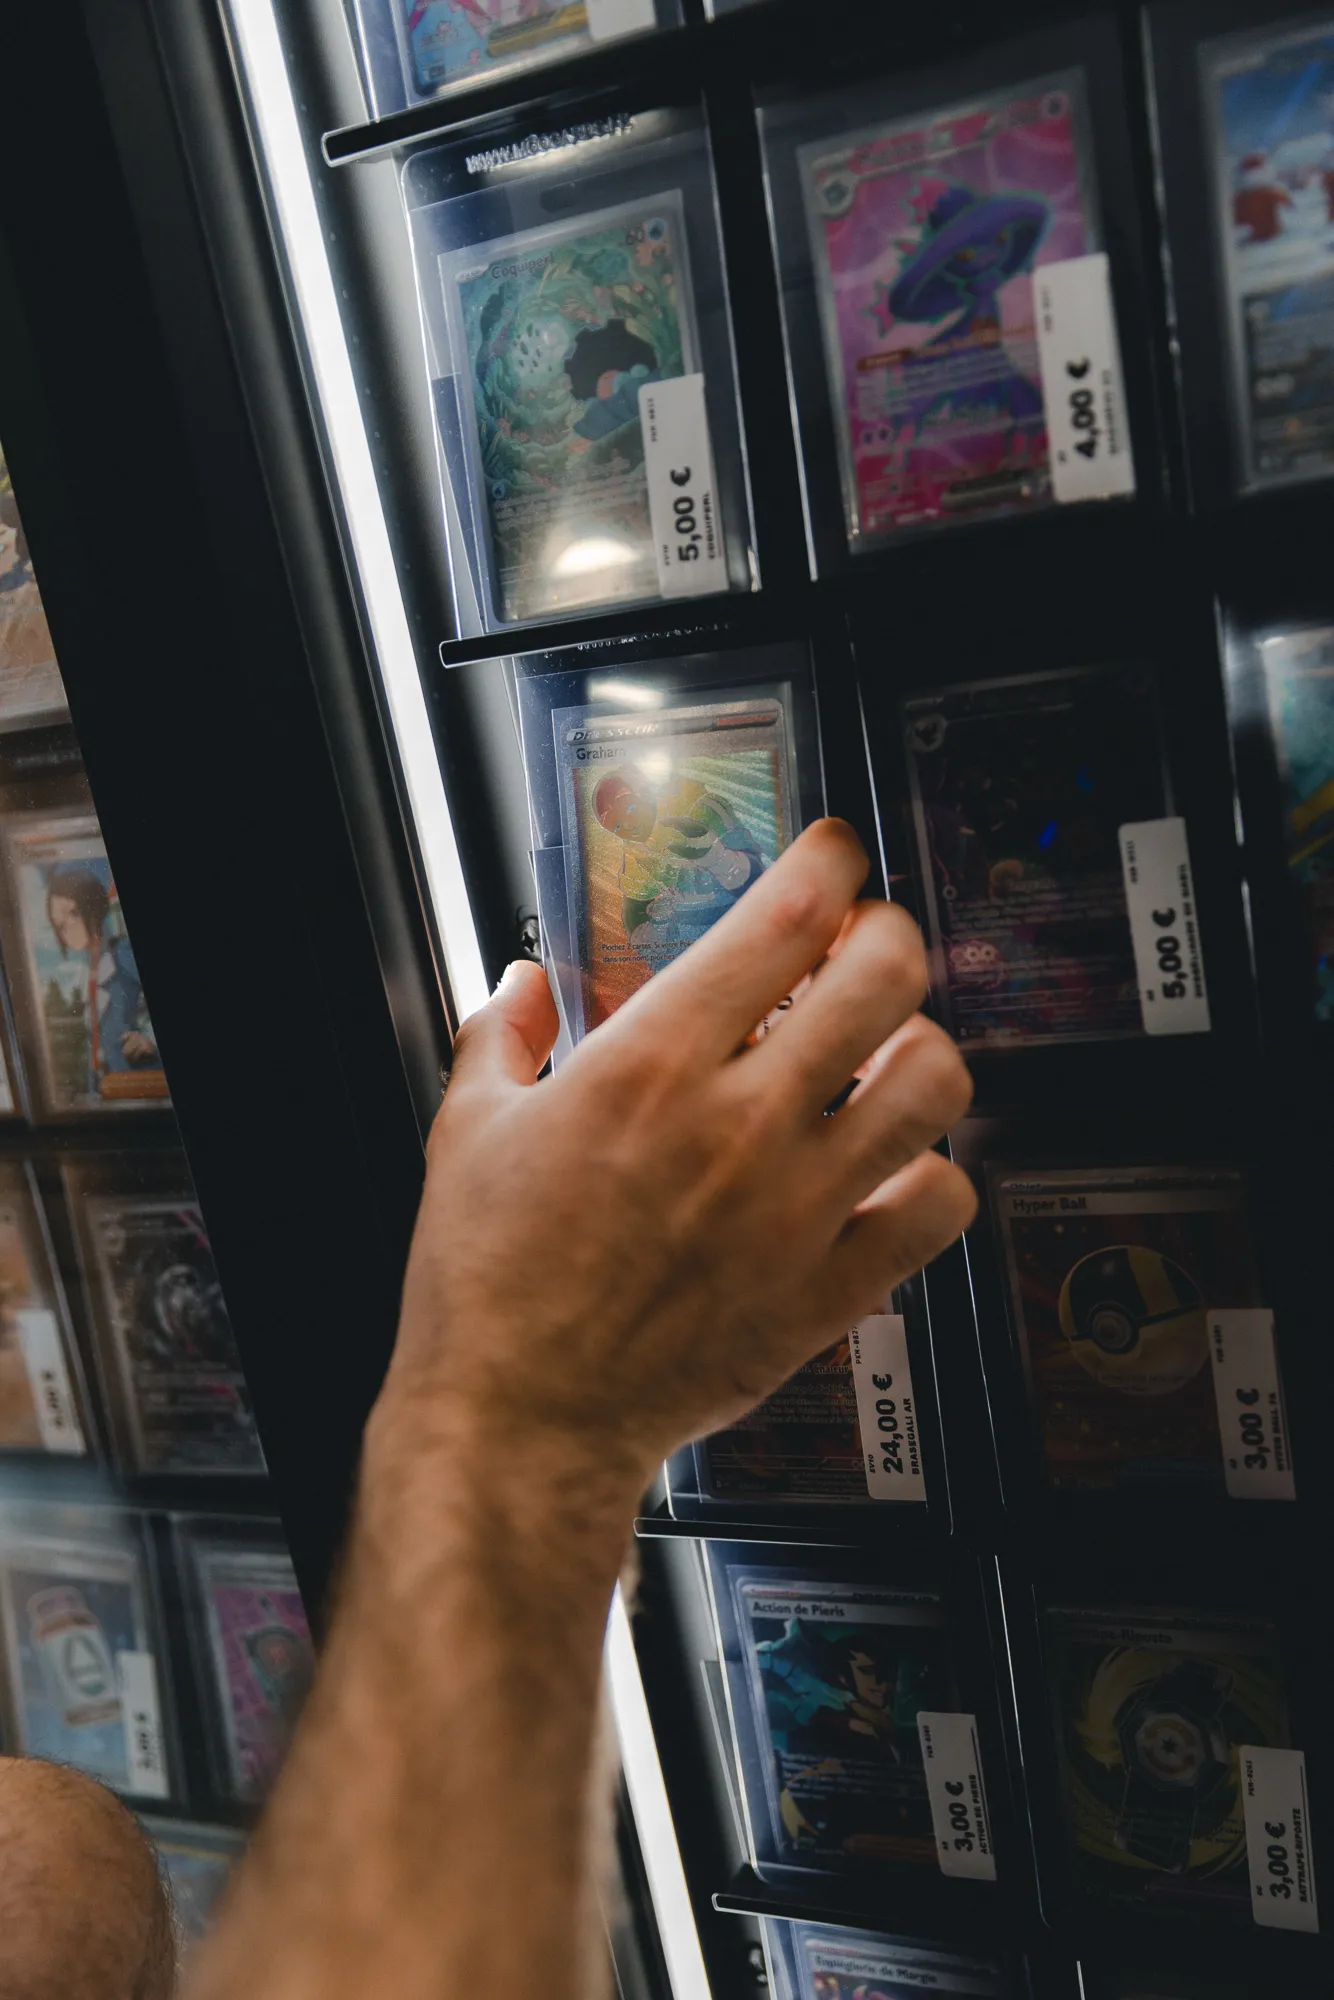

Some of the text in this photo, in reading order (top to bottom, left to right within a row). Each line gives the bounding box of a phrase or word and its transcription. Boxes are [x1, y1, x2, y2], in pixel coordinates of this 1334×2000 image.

[1067, 360, 1100, 459] 4,00 €
[670, 467, 702, 561] 5,00 €
[1152, 908, 1188, 999] 5,00 €
[1012, 1196, 1087, 1213] Hyper Ball
[872, 1374, 904, 1474] 24,00 €
[903, 1399, 920, 1474] BRASEGALI AR
[1236, 1389, 1271, 1470] 3,00 €
[868, 1454, 876, 1473] EV10
[752, 1600, 846, 1619] Action de Pieris
[945, 1781, 975, 1852] 3,00 €
[976, 1820, 988, 1854] ACTION
[1265, 1822, 1294, 1899] 3,00 €
